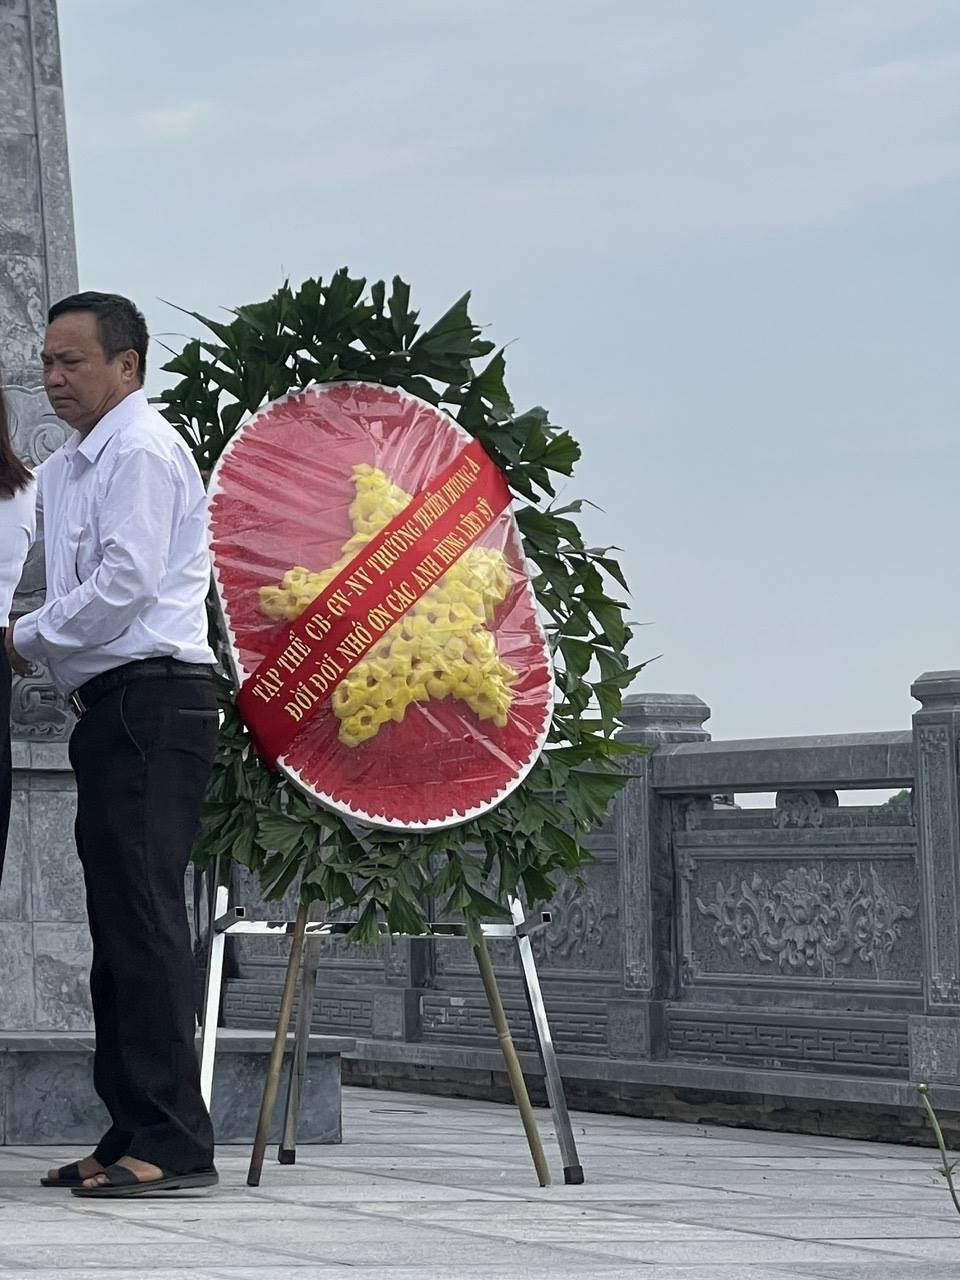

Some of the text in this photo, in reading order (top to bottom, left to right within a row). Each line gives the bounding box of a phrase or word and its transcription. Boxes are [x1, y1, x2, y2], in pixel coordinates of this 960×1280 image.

[252, 668, 284, 703] TẬP
[277, 630, 311, 674] THỂ
[366, 519, 422, 575] TRƯỜNG
[464, 455, 481, 474] A
[336, 621, 373, 663] NHỚ
[368, 603, 394, 631] ƠN
[386, 580, 417, 613] CÁC
[411, 555, 443, 590] ANH
[433, 532, 468, 565] HÙNG
